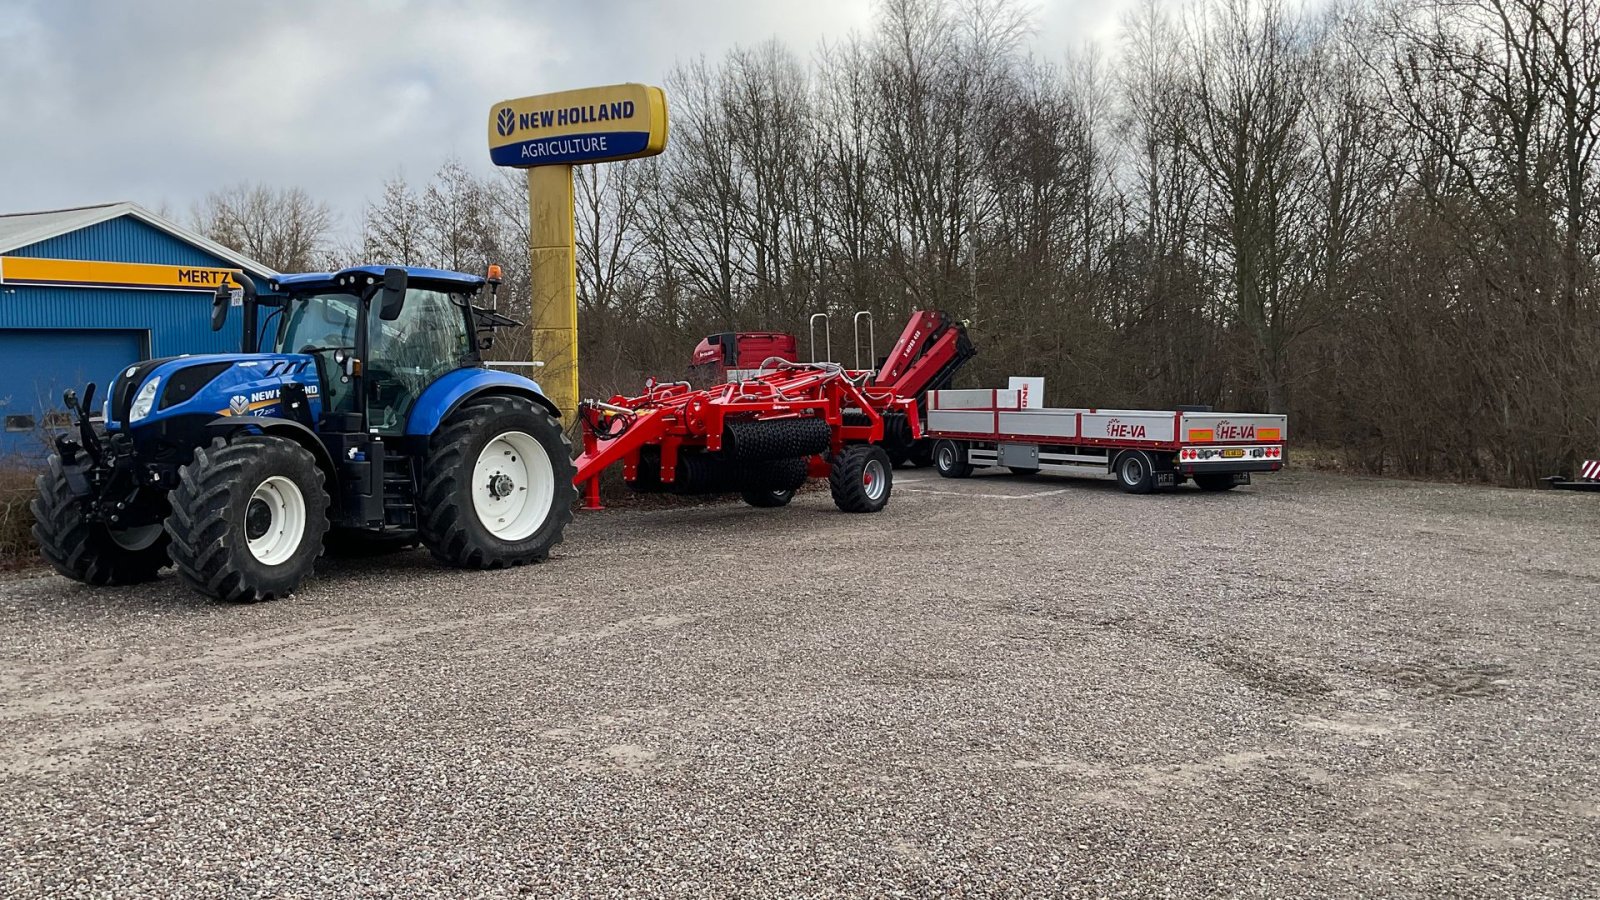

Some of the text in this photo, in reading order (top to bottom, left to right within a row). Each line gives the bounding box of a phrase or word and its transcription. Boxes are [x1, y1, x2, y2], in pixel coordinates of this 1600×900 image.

[519, 101, 635, 130] NEW HOLLAND
[521, 136, 607, 158] AGRICULTURE
[178, 269, 231, 284] MERTZ
[251, 389, 275, 402] NEW
[1110, 424, 1146, 438] HE-VA
[1220, 426, 1255, 439] HE-VA
